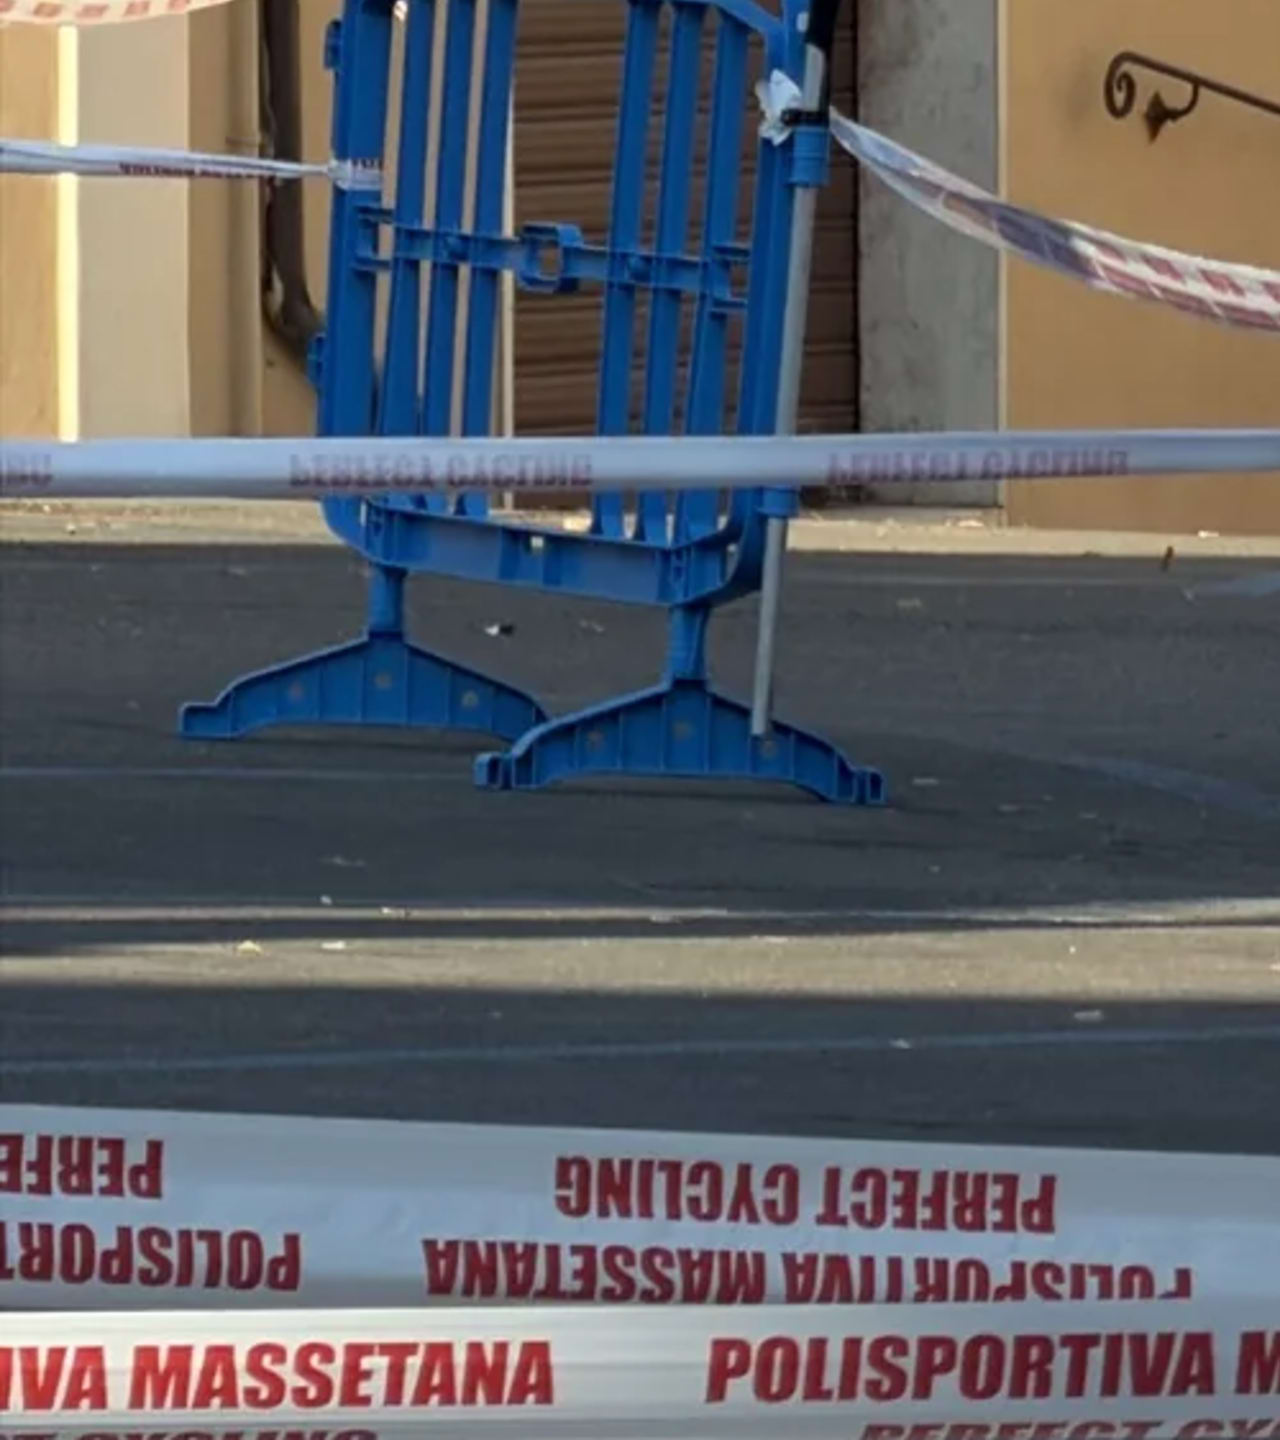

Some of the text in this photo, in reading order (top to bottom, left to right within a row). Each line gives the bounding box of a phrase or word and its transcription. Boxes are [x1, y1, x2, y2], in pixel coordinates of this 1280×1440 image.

[555, 1157, 1057, 1234] PERFECT CYCLING
[422, 1239, 767, 1305] MASSETANA
[126, 1339, 556, 1413] MASSETANA
[705, 1331, 1217, 1405] POLISPORTIVA
